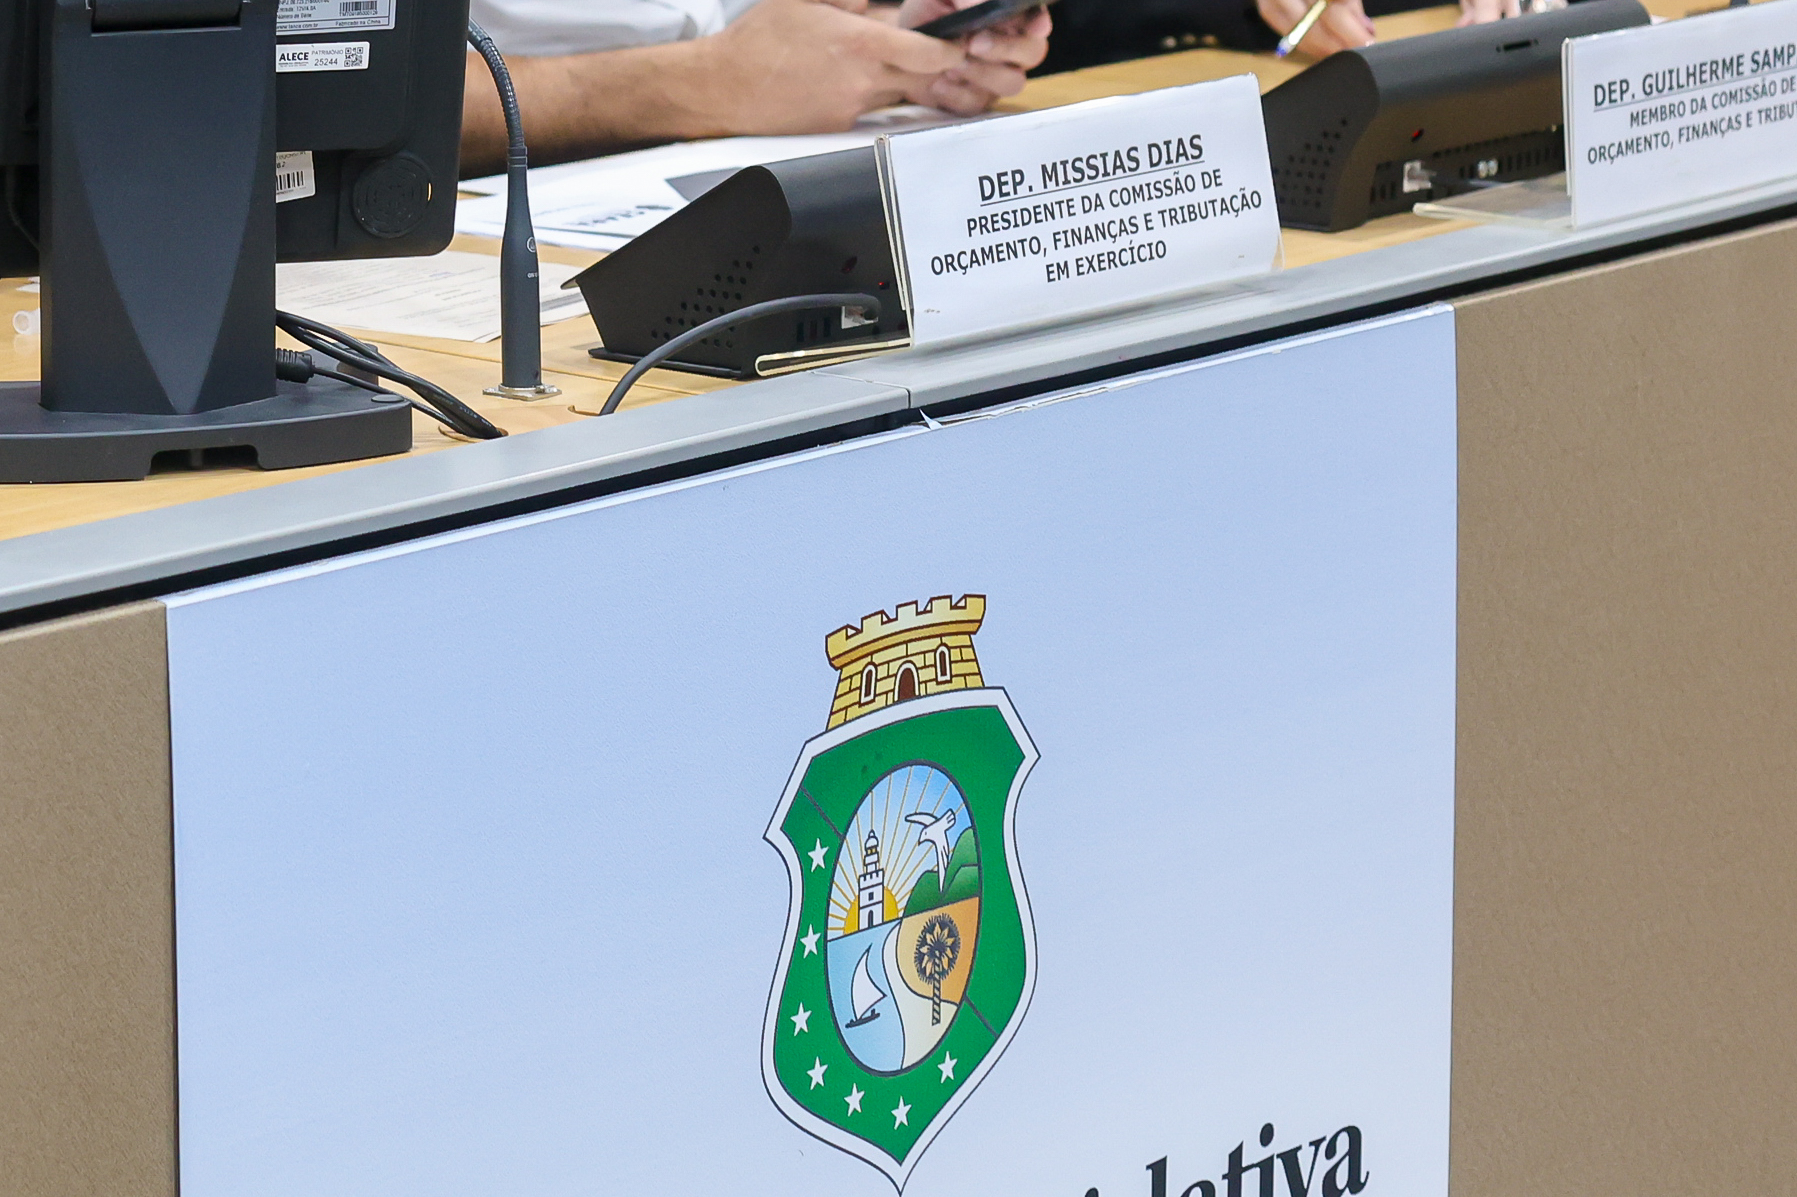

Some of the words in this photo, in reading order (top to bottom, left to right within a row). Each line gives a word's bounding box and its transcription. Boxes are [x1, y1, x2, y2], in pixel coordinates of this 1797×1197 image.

[278, 52, 309, 62] ALECE
[314, 58, 338, 66] 25244
[1594, 79, 1635, 107] DEP.
[1642, 54, 1744, 96] GUILHERME
[1751, 44, 1796, 73] SAMP
[1630, 100, 1686, 128] MEMBRO
[1690, 96, 1707, 115] DA
[1712, 77, 1776, 109] COMISSÃO
[1782, 76, 1795, 94] DE
[1588, 131, 1673, 164] ORÇAMENTO,
[1678, 114, 1741, 143] FINANÇAS
[1746, 111, 1753, 128] E
[978, 168, 1034, 201] DEP.
[1041, 147, 1140, 189] MISSIAS
[1148, 135, 1203, 168] DIAS
[967, 200, 1076, 237] PRESIDENTE
[1081, 194, 1105, 214] DA
[1109, 171, 1196, 208] COMISSÃO
[1201, 169, 1223, 189] DE
[931, 236, 1048, 276] ORÇAMENTO,
[1053, 214, 1139, 251] FINANÇAS
[1144, 212, 1154, 231] E
[1159, 187, 1262, 228] TRIBUTAÇÃO
[1046, 261, 1069, 283] EM
[1076, 240, 1167, 276] EXERCÍCIO
